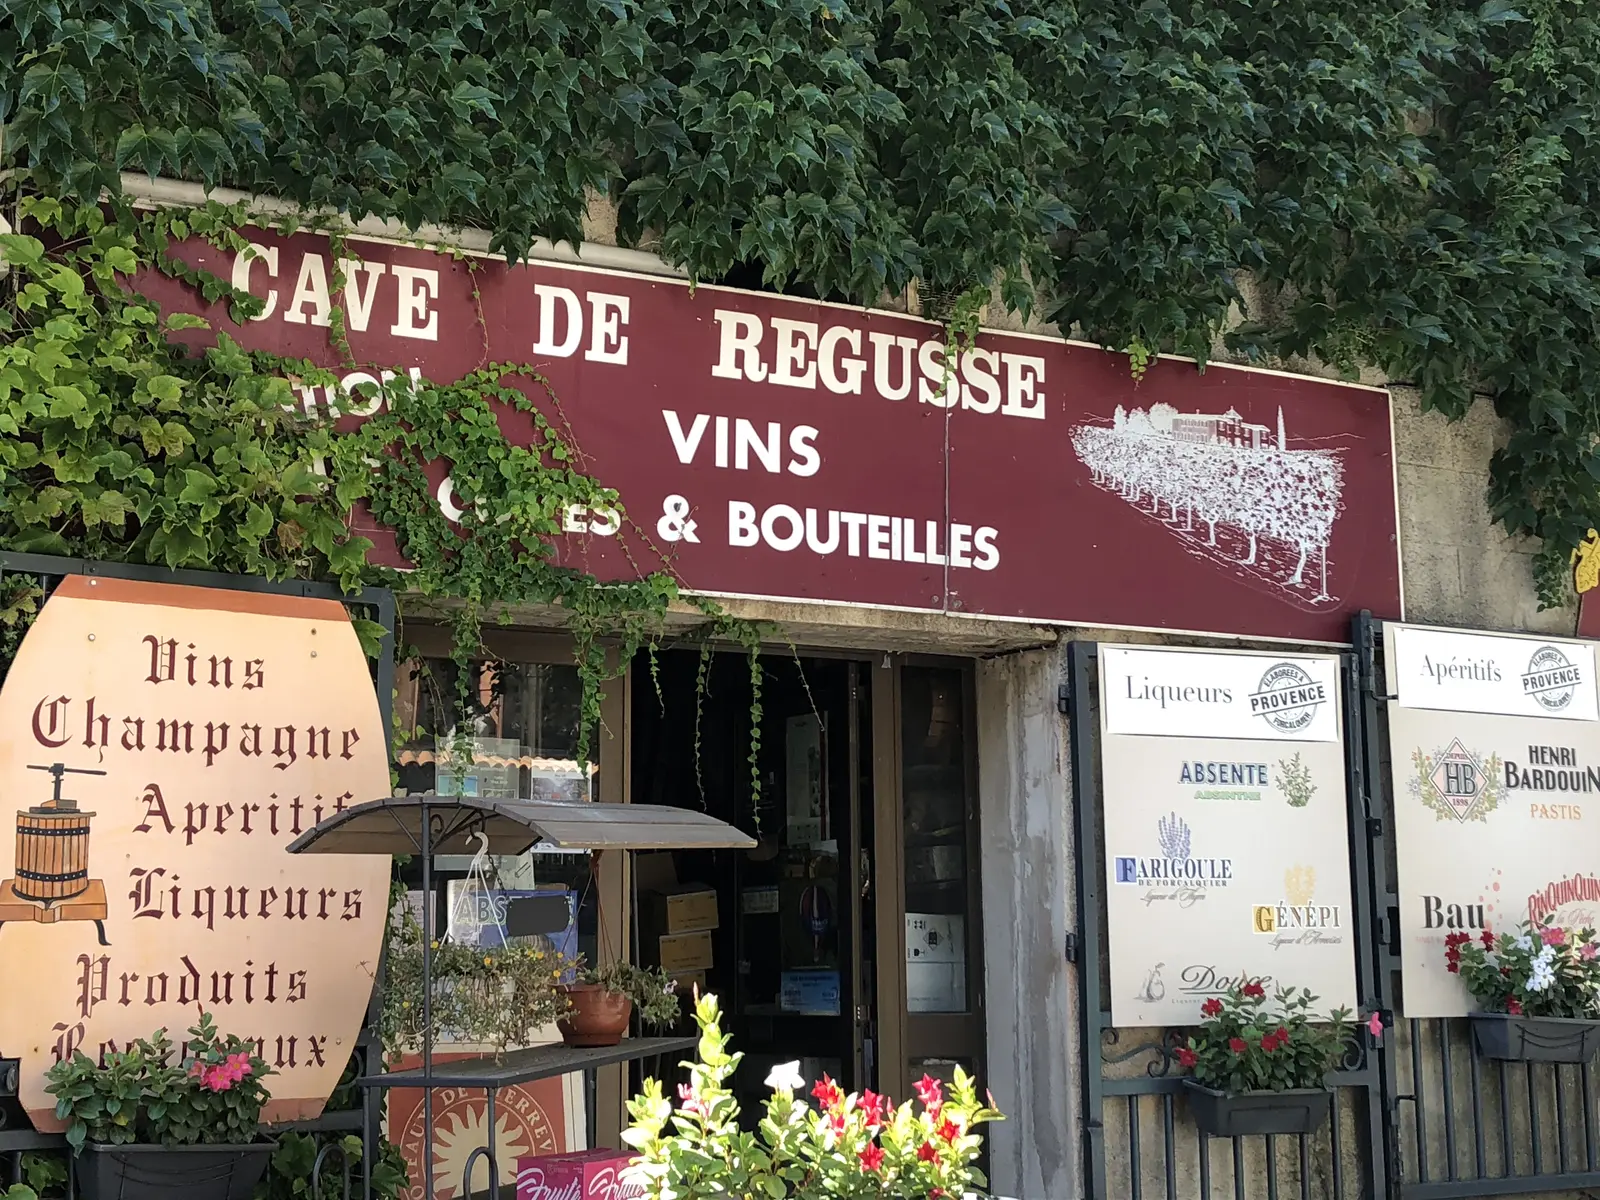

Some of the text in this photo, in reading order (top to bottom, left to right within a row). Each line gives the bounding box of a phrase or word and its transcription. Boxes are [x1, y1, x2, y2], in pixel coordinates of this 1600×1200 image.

[231, 242, 1047, 421] CAVE DE REGUSSE
[662, 409, 822, 478] VINS
[656, 493, 701, 544] &
[728, 499, 1001, 572] BOUTEILLES
[142, 634, 266, 691] Vins
[1420, 654, 1503, 685] Apéritifs
[1125, 674, 1234, 709] Liqueurs
[1522, 668, 1581, 691] PROVENCE
[1250, 685, 1326, 712] PROVENCE
[31, 694, 361, 771] Champagne
[1528, 745, 1577, 767] HENRI
[1178, 760, 1269, 787] ABSENTE
[1442, 762, 1477, 795] HB
[1504, 761, 1600, 794] BARDOUIN
[1193, 790, 1262, 801] ABSINTHE
[1452, 798, 1469, 807] 1898
[1530, 803, 1582, 821] PASTIS
[1118, 856, 1233, 883] FARIGOULE
[1138, 879, 1228, 888] DE FORCALQUIER
[128, 866, 364, 932] Liqueurs
[1420, 895, 1486, 929] Bau
[1255, 900, 1340, 932] GÉNÉPI
[76, 952, 309, 1018] Produits
